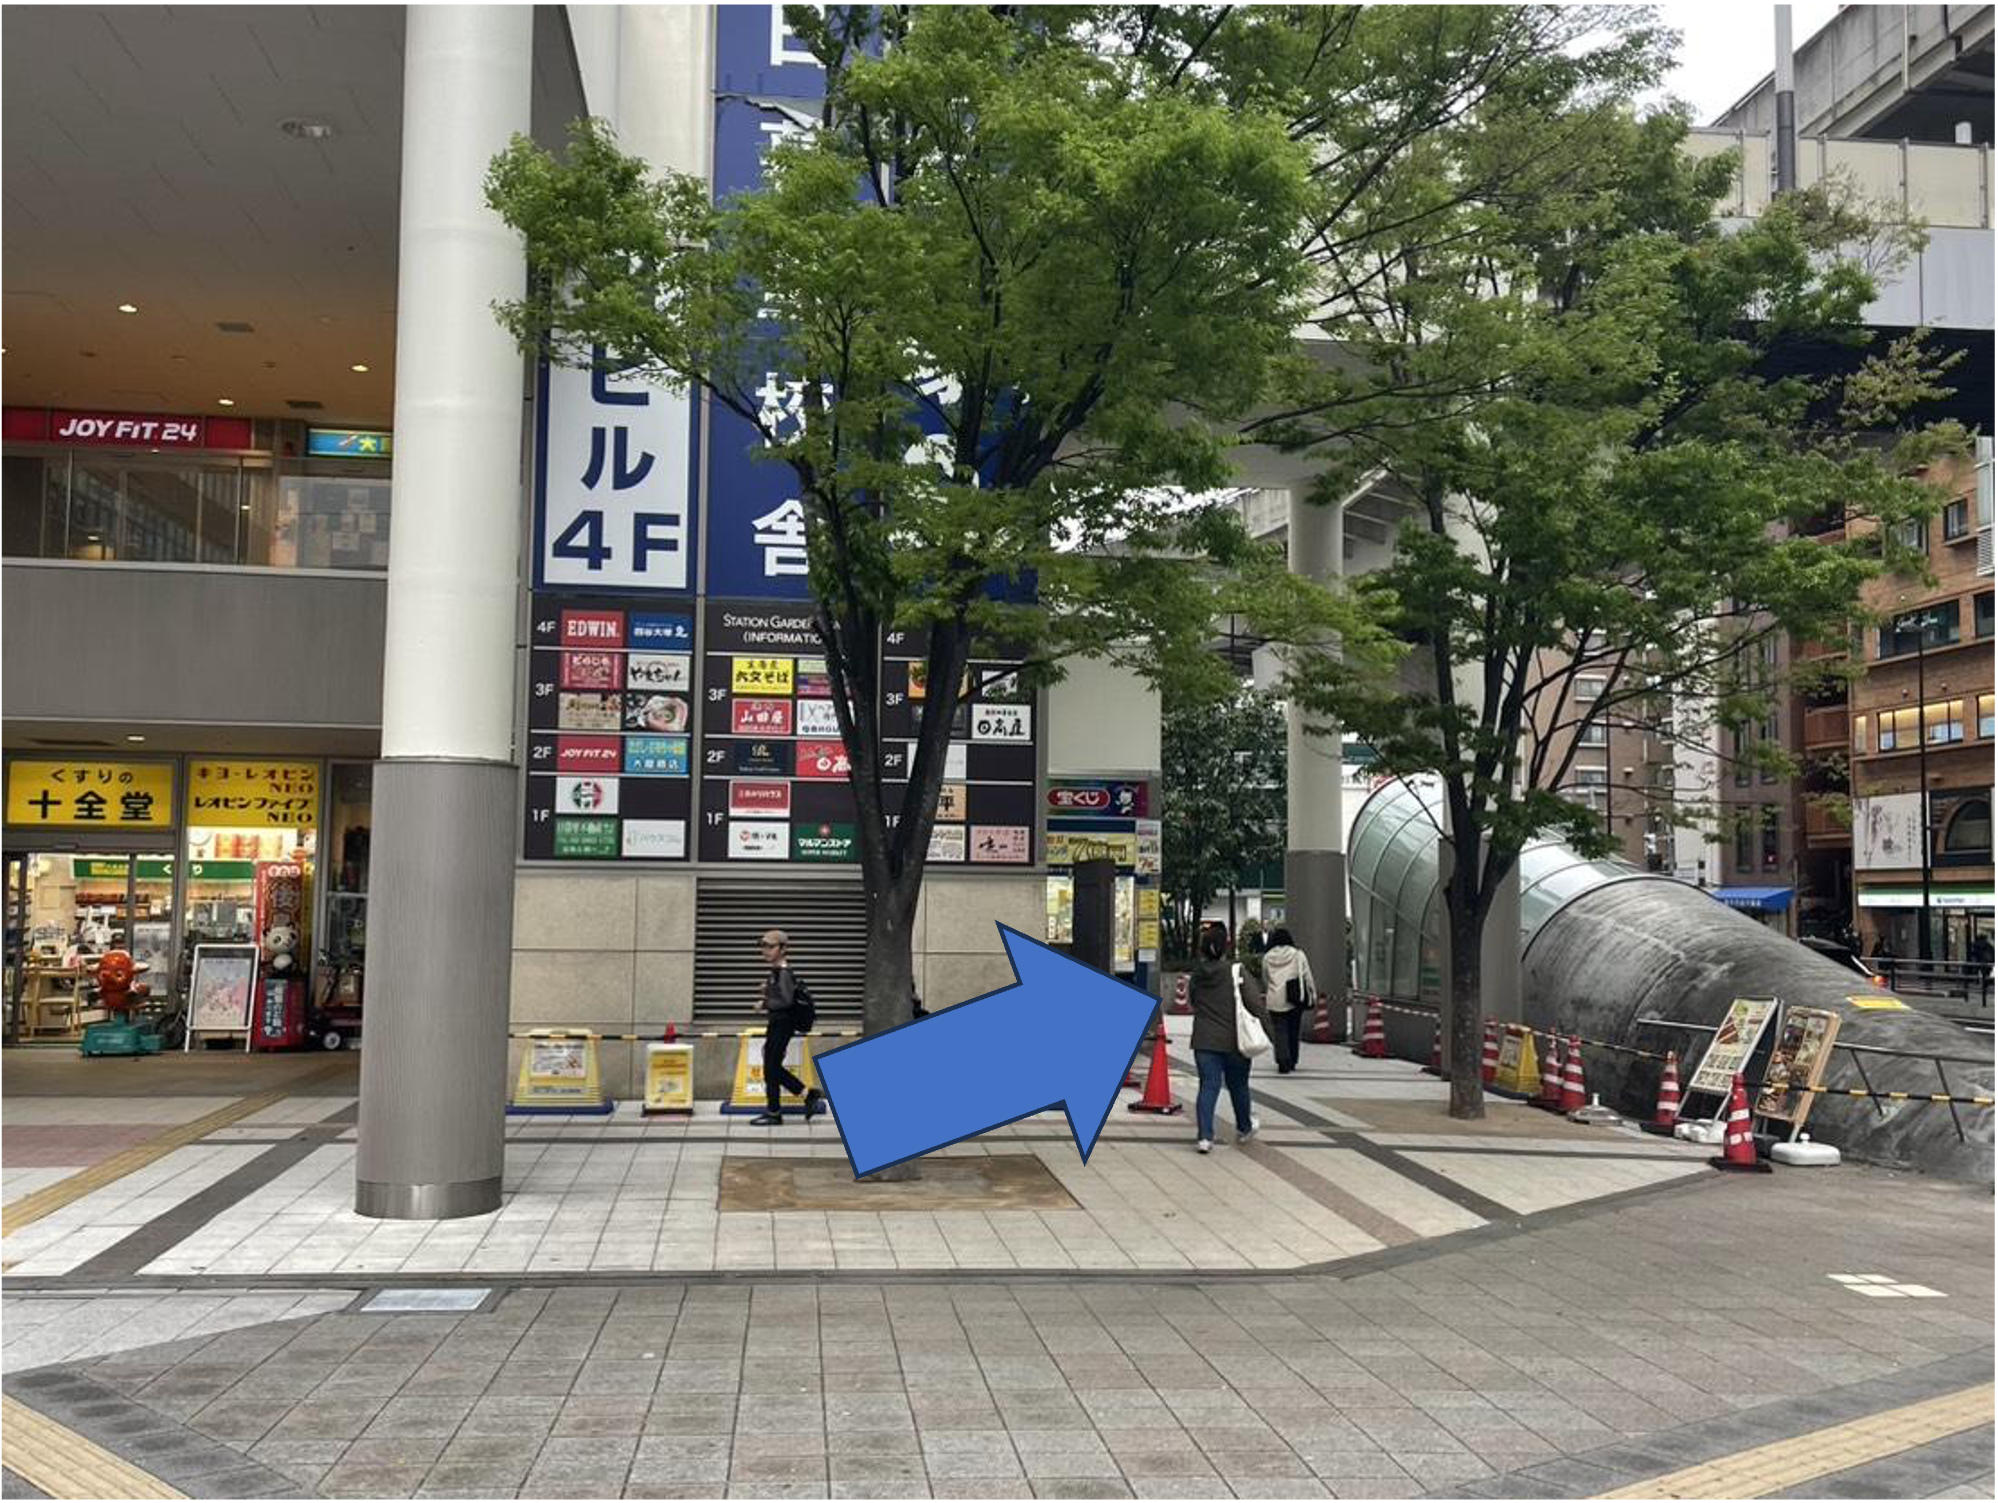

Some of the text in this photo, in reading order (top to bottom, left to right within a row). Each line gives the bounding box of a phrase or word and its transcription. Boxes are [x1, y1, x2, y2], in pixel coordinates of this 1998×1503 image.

[59, 419, 114, 437] JOY
[161, 422, 197, 440] 24
[552, 510, 681, 573] 4F
[537, 621, 556, 633] 4F
[567, 620, 617, 637] EDWIN
[770, 615, 813, 630] GARDE
[887, 631, 905, 644] 4F
[535, 683, 554, 696] 3F
[708, 688, 727, 701] 3F
[886, 692, 903, 705] 3F
[533, 747, 552, 758] 2F
[706, 750, 726, 764] 2F
[885, 754, 902, 767] 2F
[51, 768, 133, 784] くすりの
[270, 782, 314, 793] NEO
[28, 789, 154, 821] 十全堂
[267, 812, 313, 823] NEO
[532, 809, 550, 822] 1F
[706, 812, 724, 826] 1F
[885, 815, 902, 828] 1F
